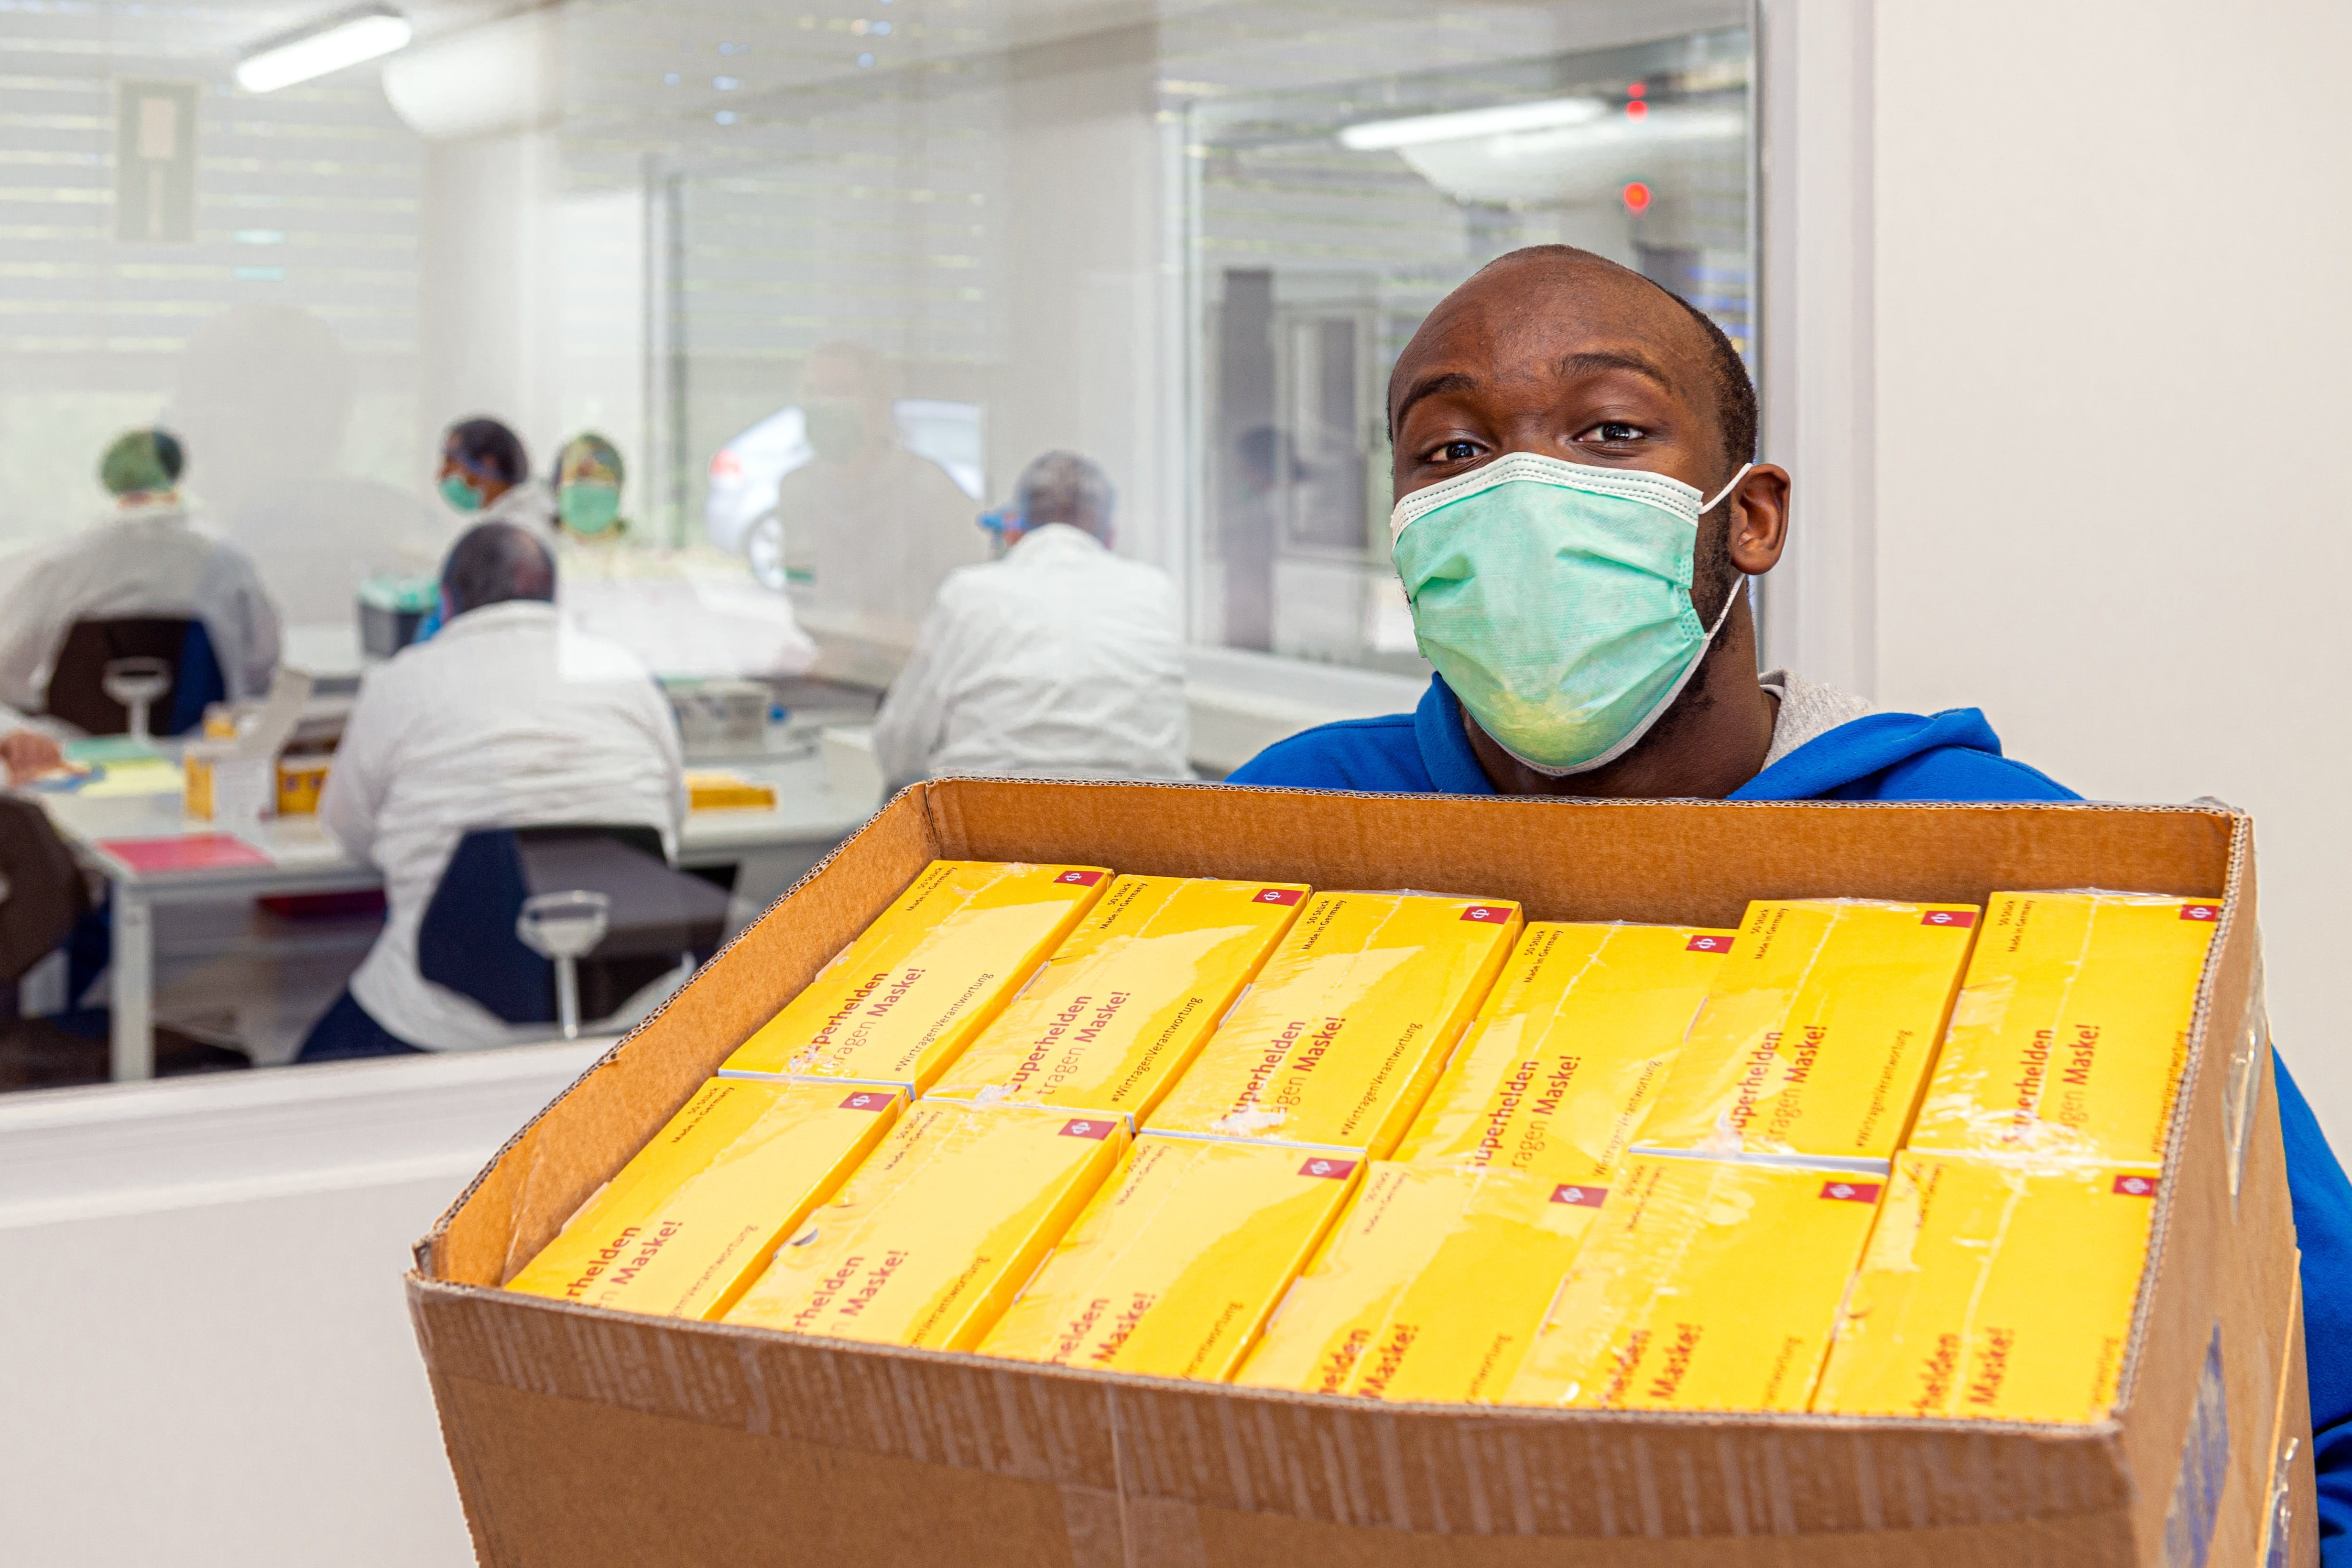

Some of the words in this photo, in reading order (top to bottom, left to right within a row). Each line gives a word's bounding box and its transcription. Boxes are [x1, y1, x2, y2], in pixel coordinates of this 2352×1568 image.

[906, 896, 926, 911] Made
[928, 866, 958, 890] Germany
[1100, 914, 1119, 929] Made
[1120, 883, 1148, 907] Germany
[1114, 882, 1133, 898] Stück
[1313, 900, 1330, 915] Stück
[2015, 900, 2037, 926] Germany
[1302, 933, 1320, 950] Made
[1320, 900, 1347, 926] Germany
[1530, 930, 1546, 947] Stück
[1754, 943, 1770, 959] Made
[1766, 908, 1789, 935] Germany
[1524, 966, 1541, 983] Made
[1538, 930, 1564, 957] Germany
[833, 1021, 876, 1061] ragen
[866, 968, 926, 1017] Maske!
[894, 972, 994, 1072] #WirtragenVerantwortung
[1035, 1046, 1086, 1095] tragen
[1074, 991, 1131, 1043] Maske!
[1292, 1016, 1347, 1072] Maske!
[1111, 997, 1203, 1103] #WirtragenVerantwortung
[1221, 1020, 1306, 1121] uperhelden
[1341, 1022, 1423, 1136] #WirtragenVerantwortung
[1783, 1025, 1828, 1083] Maske!
[2062, 1024, 2101, 1085] Maske!
[699, 1087, 735, 1115] Germany
[1512, 1120, 1549, 1168] ragen
[1532, 1055, 1582, 1115] Maske!
[1730, 1031, 1784, 1137] uperhelden
[566, 1226, 641, 1298] rhelden
[610, 1221, 683, 1285] Maske!
[839, 1251, 908, 1316] Maske!
[794, 1256, 865, 1331] rhelden
[1090, 1292, 1156, 1363] Maske!
